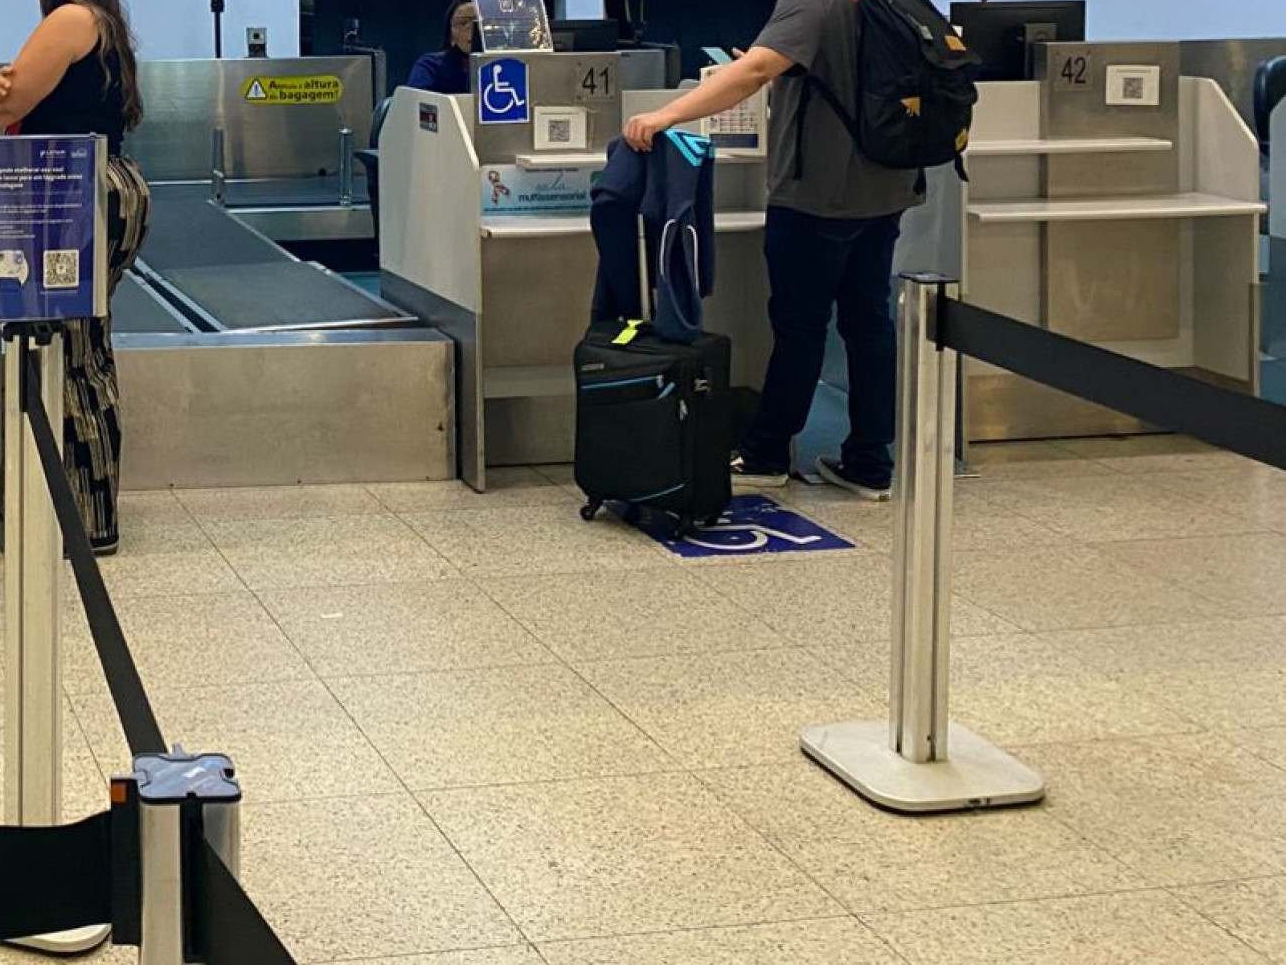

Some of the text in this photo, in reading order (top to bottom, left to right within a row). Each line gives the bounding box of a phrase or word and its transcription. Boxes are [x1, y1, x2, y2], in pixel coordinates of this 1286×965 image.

[304, 78, 339, 89] altura
[582, 67, 609, 95] 41
[1060, 56, 1087, 85] 42
